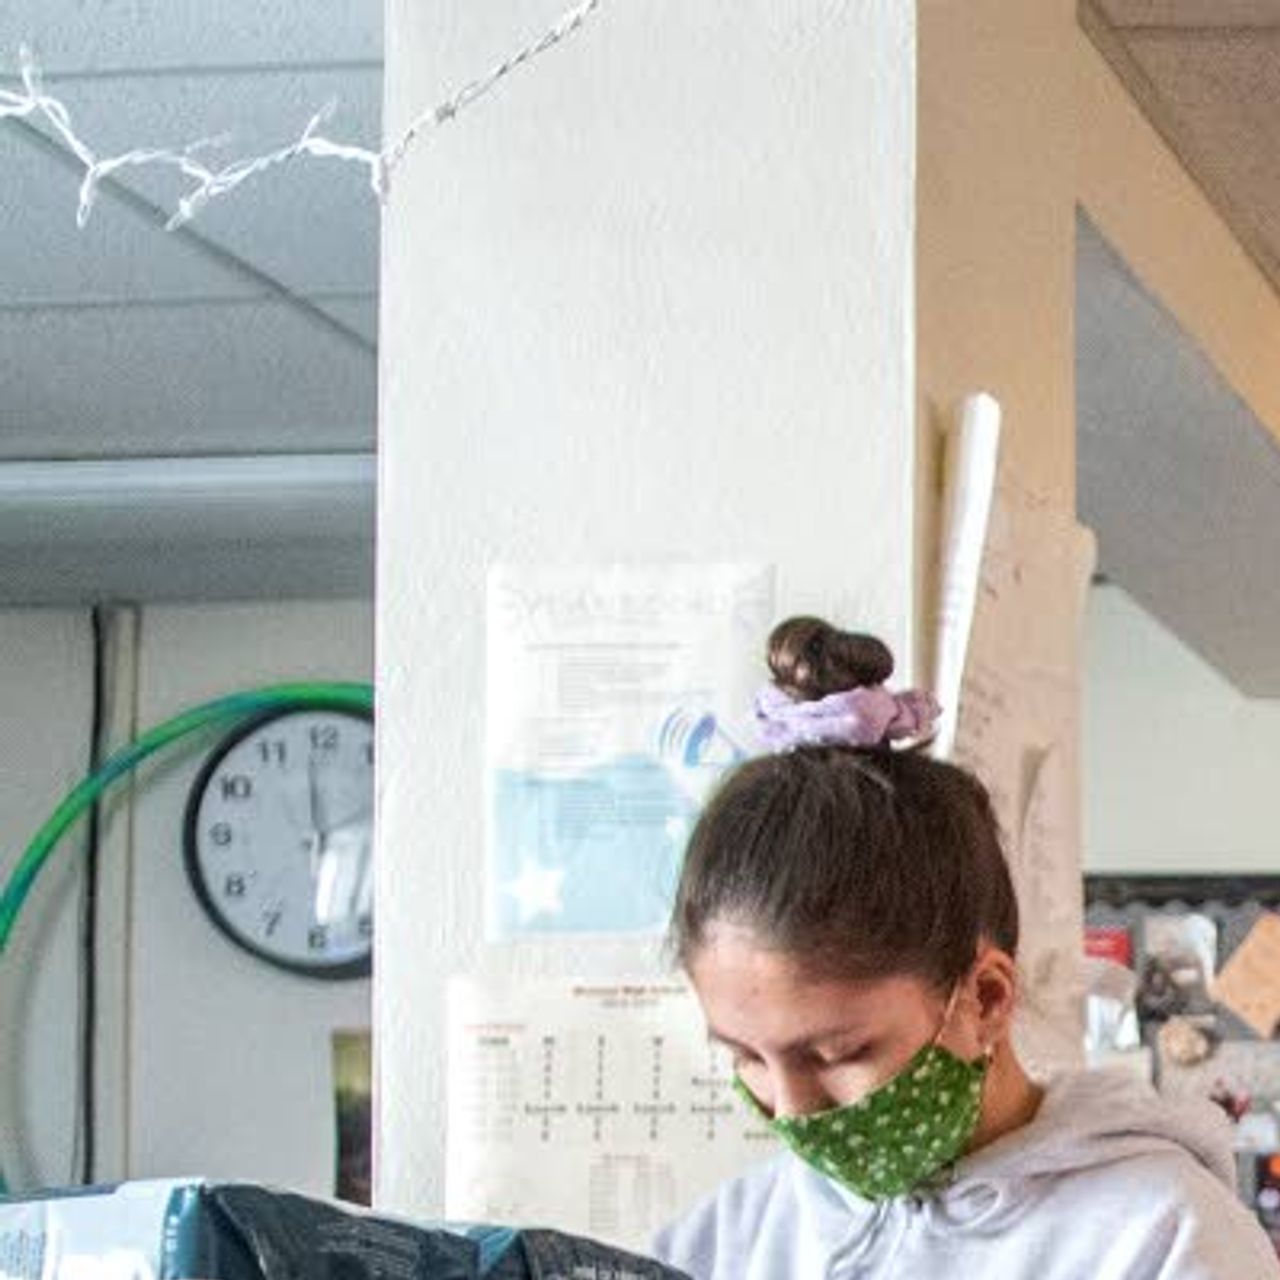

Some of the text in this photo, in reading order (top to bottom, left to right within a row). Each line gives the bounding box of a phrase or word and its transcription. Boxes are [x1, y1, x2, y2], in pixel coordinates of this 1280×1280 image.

[309, 725, 339, 750] 12
[258, 741, 287, 764] 11
[220, 773, 252, 800] 10
[210, 821, 233, 846] 9
[224, 873, 247, 898] 8
[263, 907, 283, 936] 7
[308, 925, 328, 949] 6
